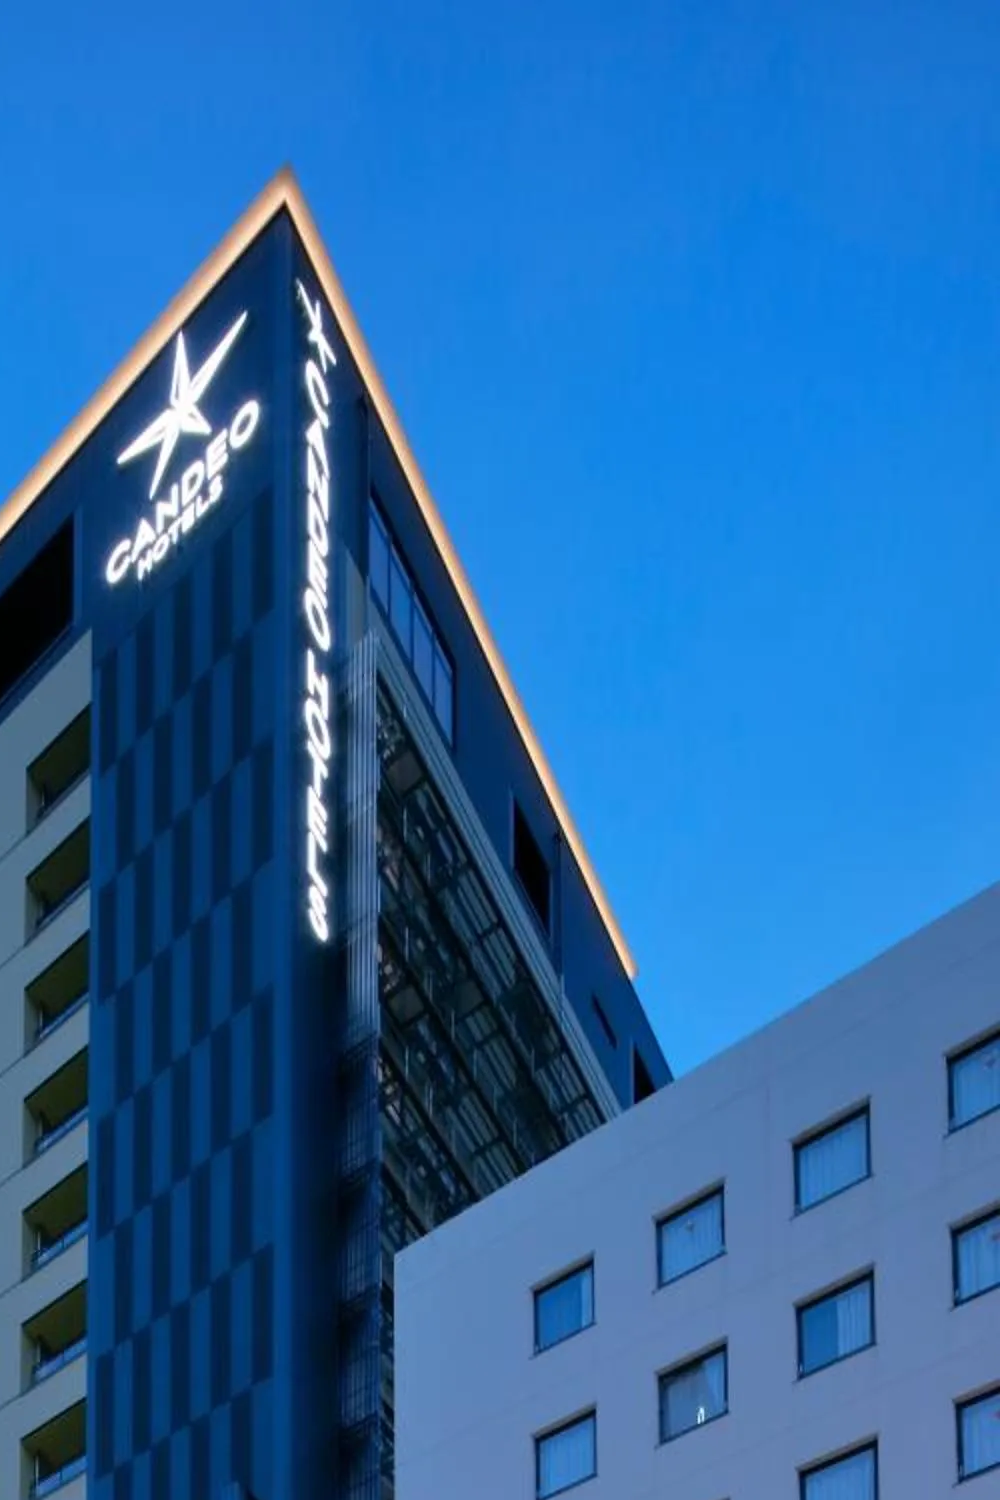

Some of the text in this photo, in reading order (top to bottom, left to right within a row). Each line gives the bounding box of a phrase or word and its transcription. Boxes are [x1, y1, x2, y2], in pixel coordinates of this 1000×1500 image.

[105, 399, 260, 585] CANDEO
[137, 474, 224, 583] HOTELS
[304, 360, 330, 942] CANDEO HOTELS
